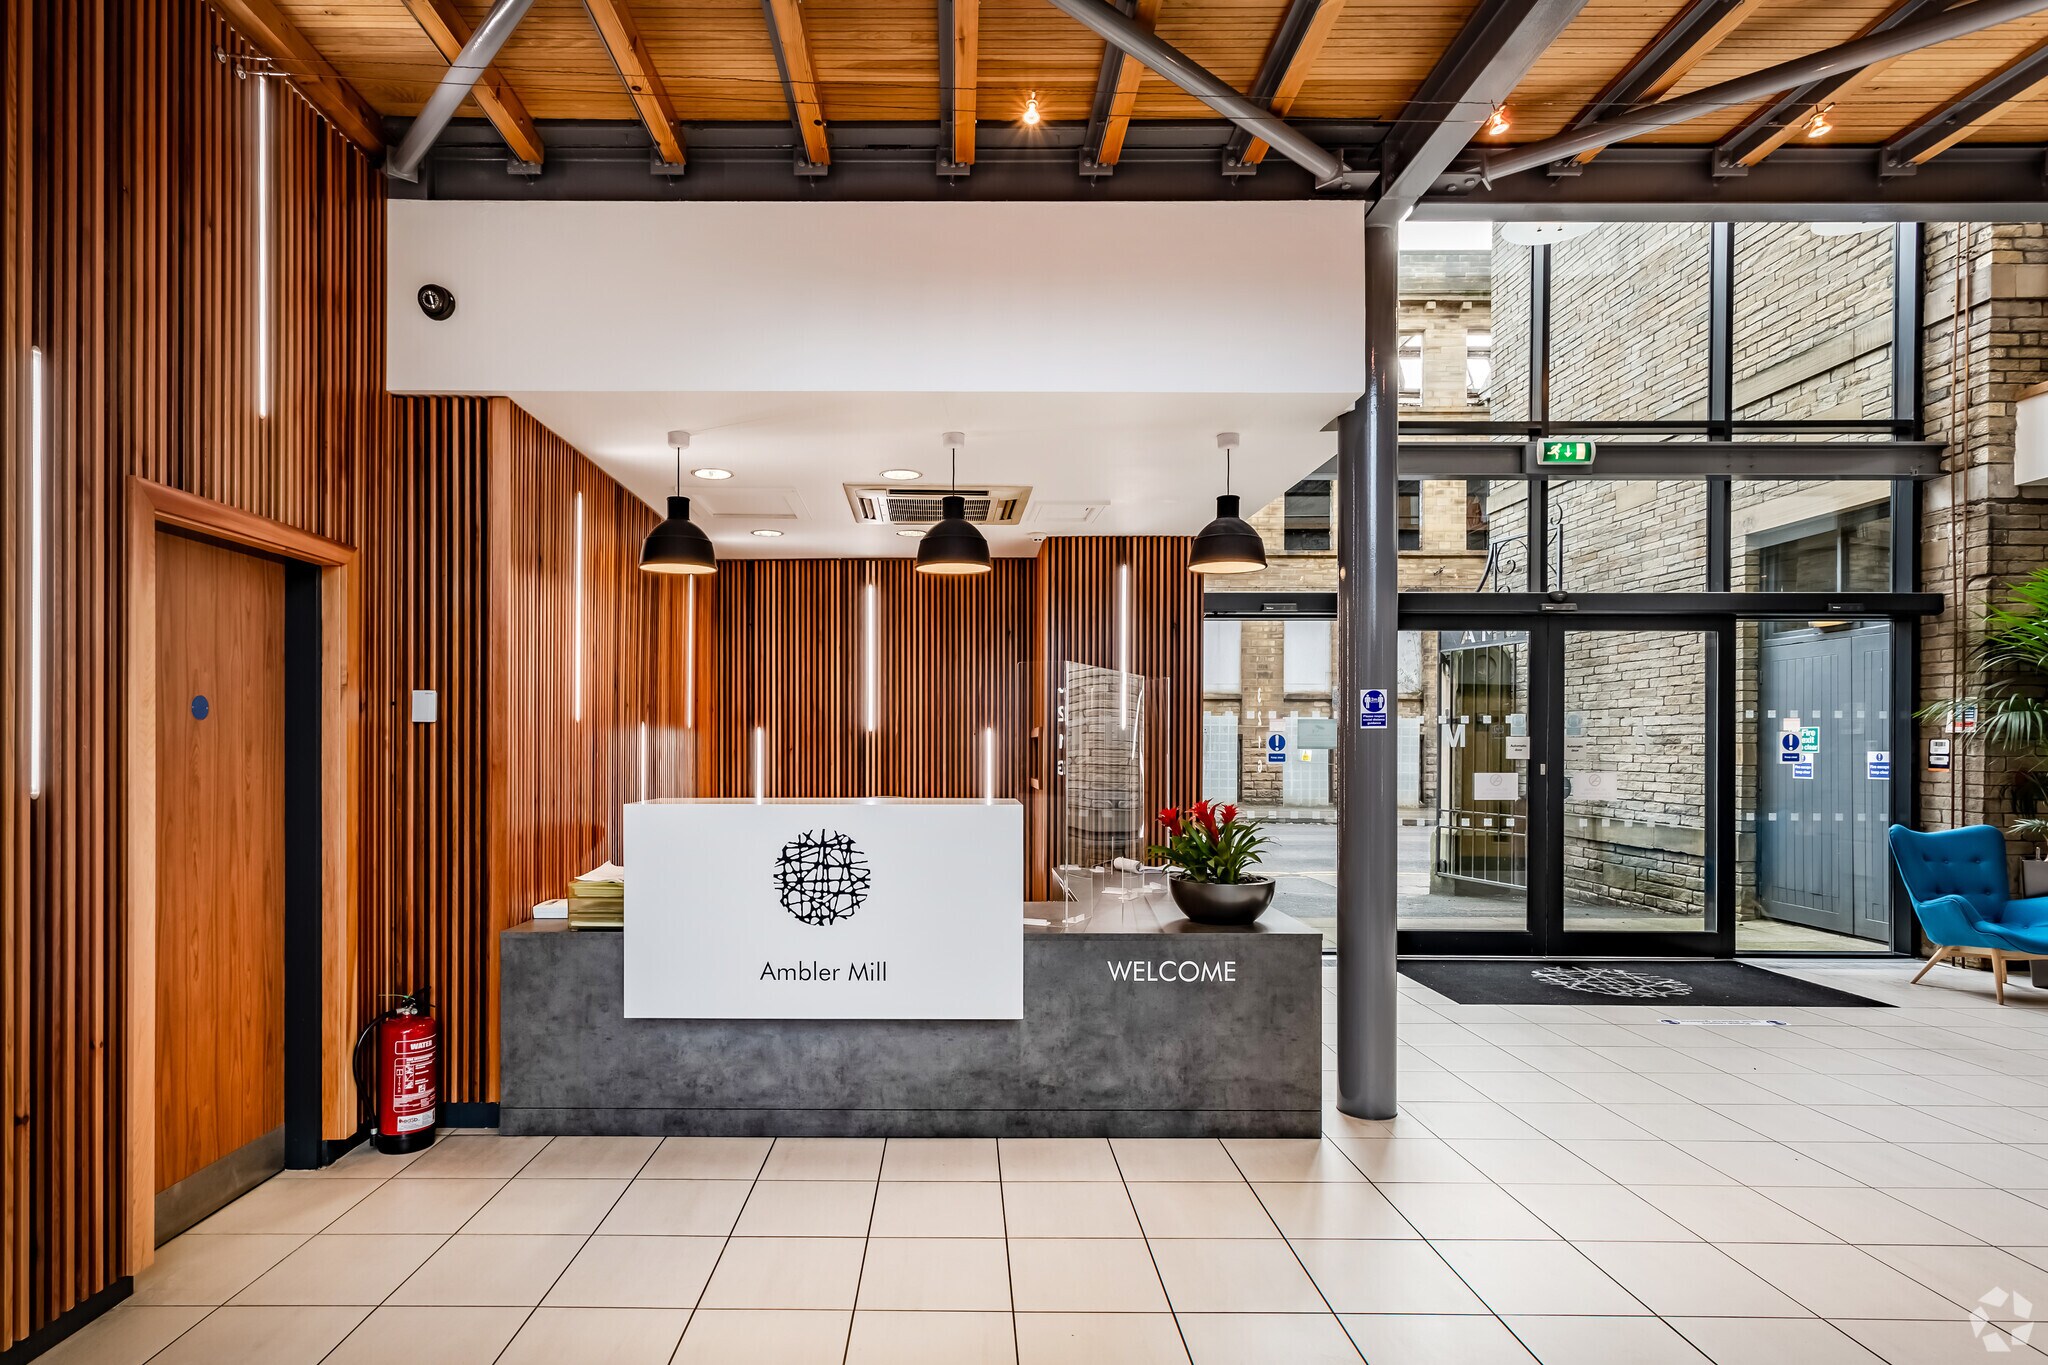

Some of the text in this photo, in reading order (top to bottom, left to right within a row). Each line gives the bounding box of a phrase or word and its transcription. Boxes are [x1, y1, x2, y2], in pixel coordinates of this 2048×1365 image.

[1802, 728, 1816, 737] Fire
[1802, 736, 1815, 744] exit
[760, 961, 886, 981] Ambler Mill
[1107, 960, 1236, 983] WELCOME
[410, 1040, 432, 1050] WATER
